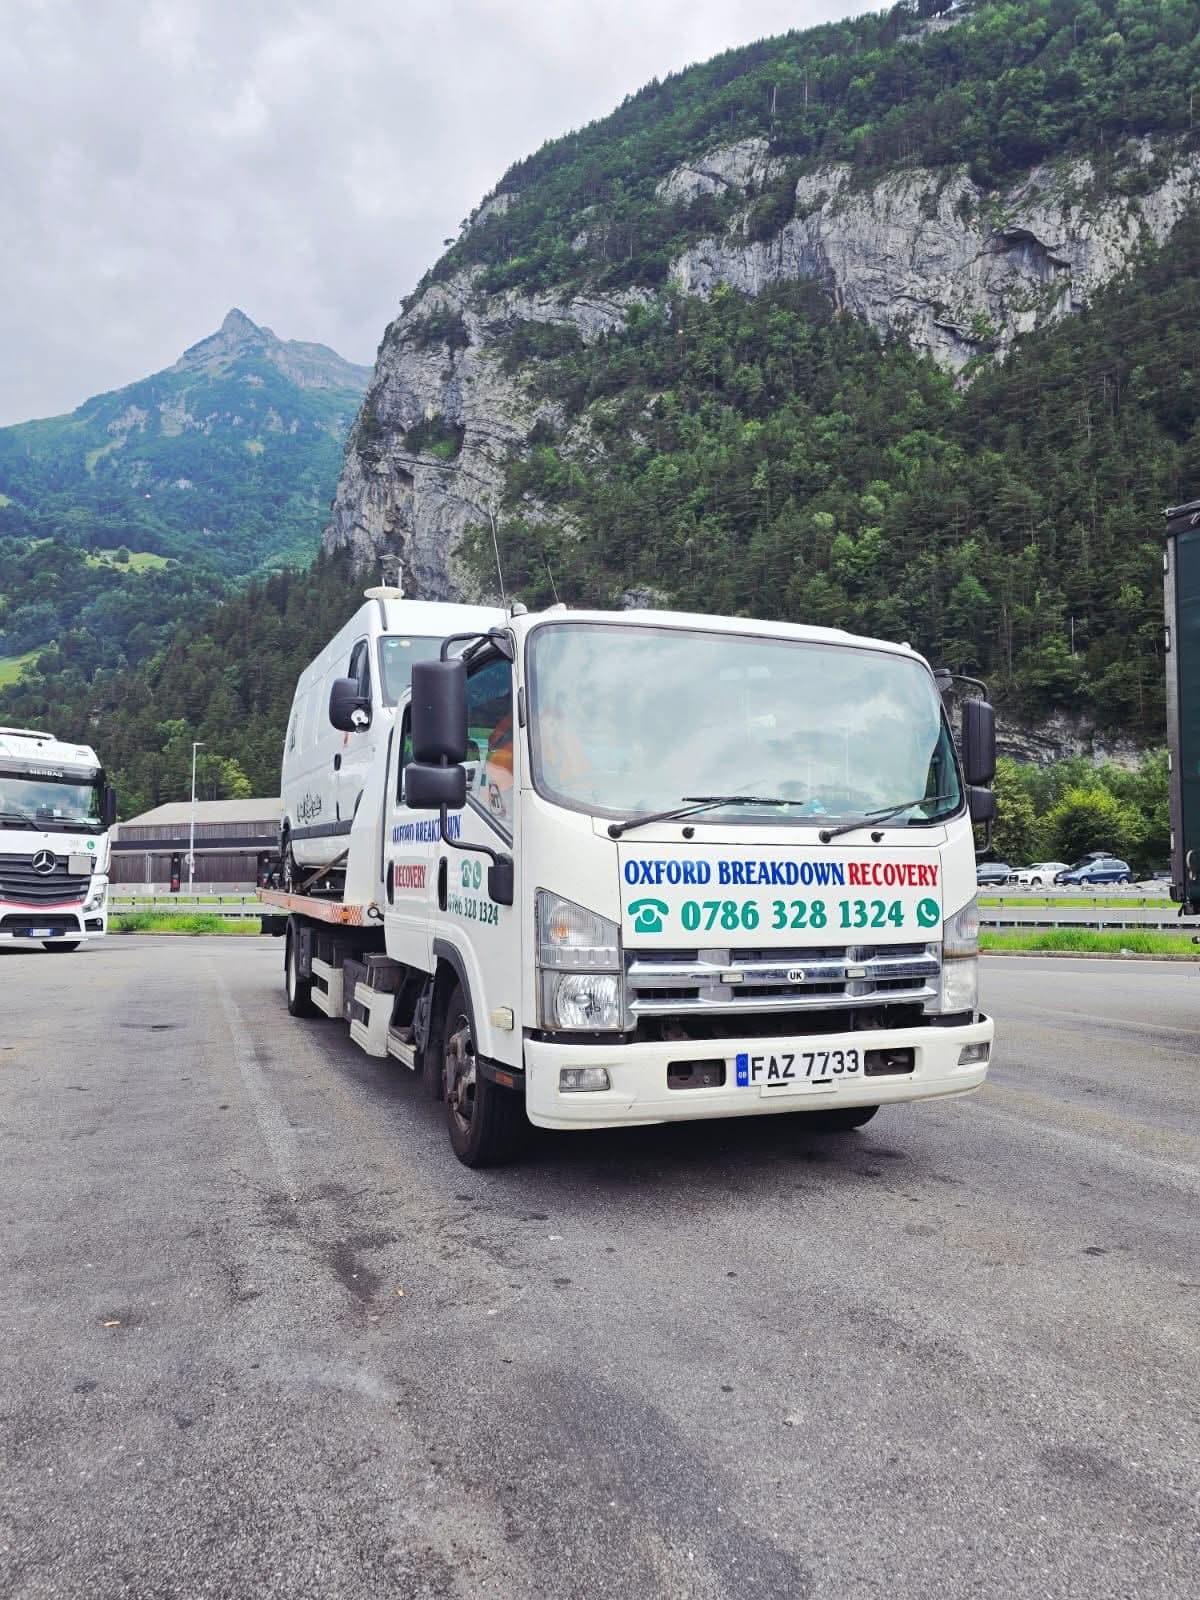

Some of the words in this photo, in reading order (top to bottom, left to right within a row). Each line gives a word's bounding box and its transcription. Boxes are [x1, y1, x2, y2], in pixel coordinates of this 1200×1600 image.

[395, 864, 426, 888] RECOVERY
[624, 859, 711, 885] OXFORD
[718, 861, 845, 886] BREAKDOWN
[847, 862, 938, 887] RECOVERY
[464, 897, 477, 919] 328
[479, 901, 499, 926] 1324
[681, 900, 760, 930] 0786
[771, 900, 827, 929] 328
[839, 899, 905, 928] 1324
[790, 970, 803, 980] UK
[751, 1054, 795, 1081] FAZ
[803, 1049, 859, 1077] 7733
